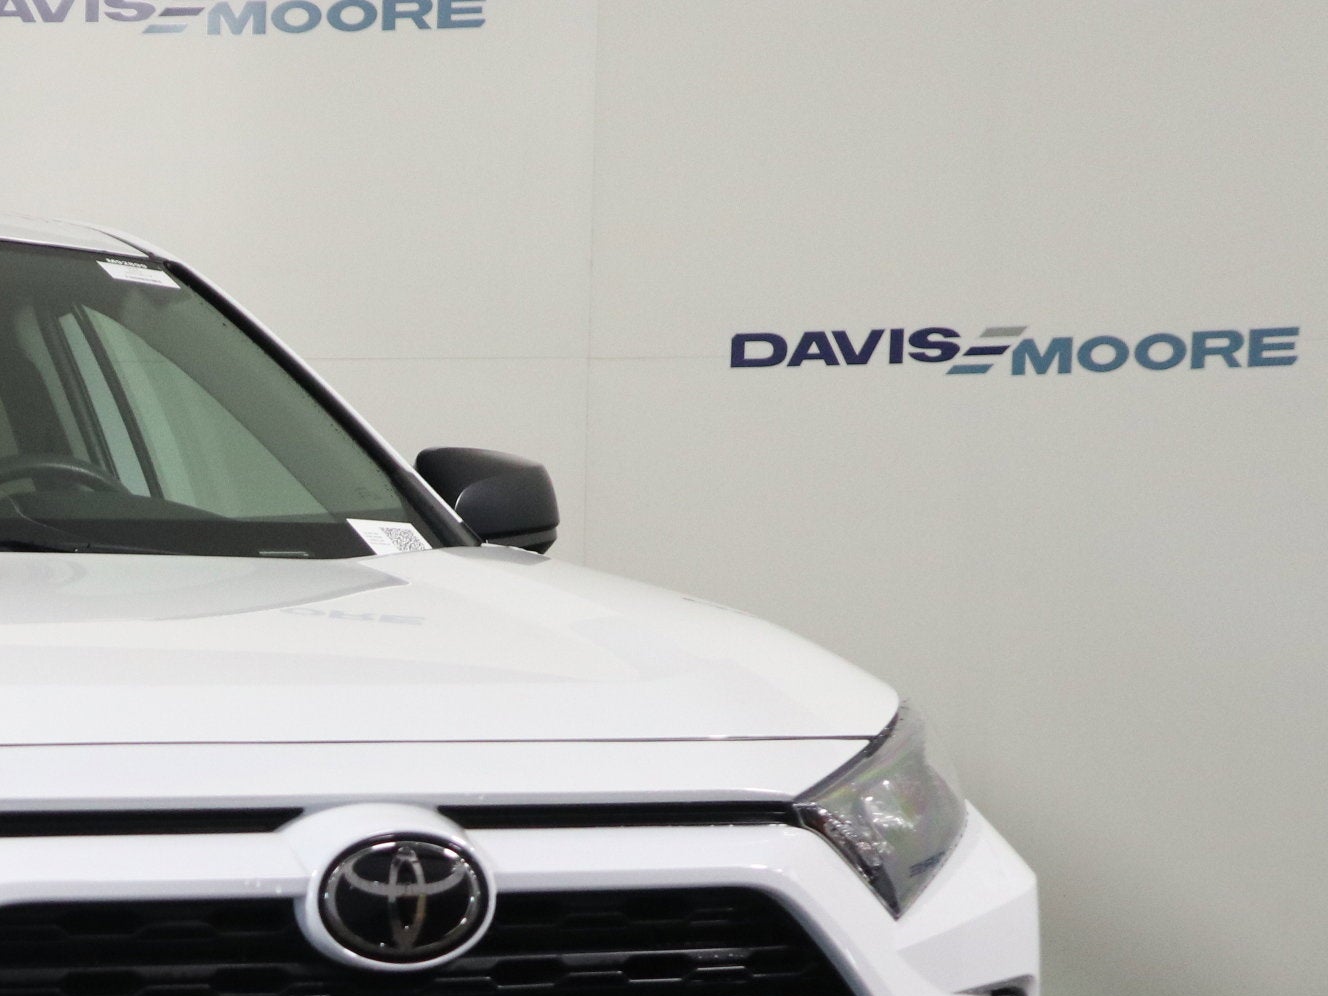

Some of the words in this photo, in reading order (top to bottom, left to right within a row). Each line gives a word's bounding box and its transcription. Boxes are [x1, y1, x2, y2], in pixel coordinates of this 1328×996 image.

[207, 0, 487, 36] MOORE
[729, 327, 961, 368] DAVIS
[1011, 326, 1301, 376] MOORE
